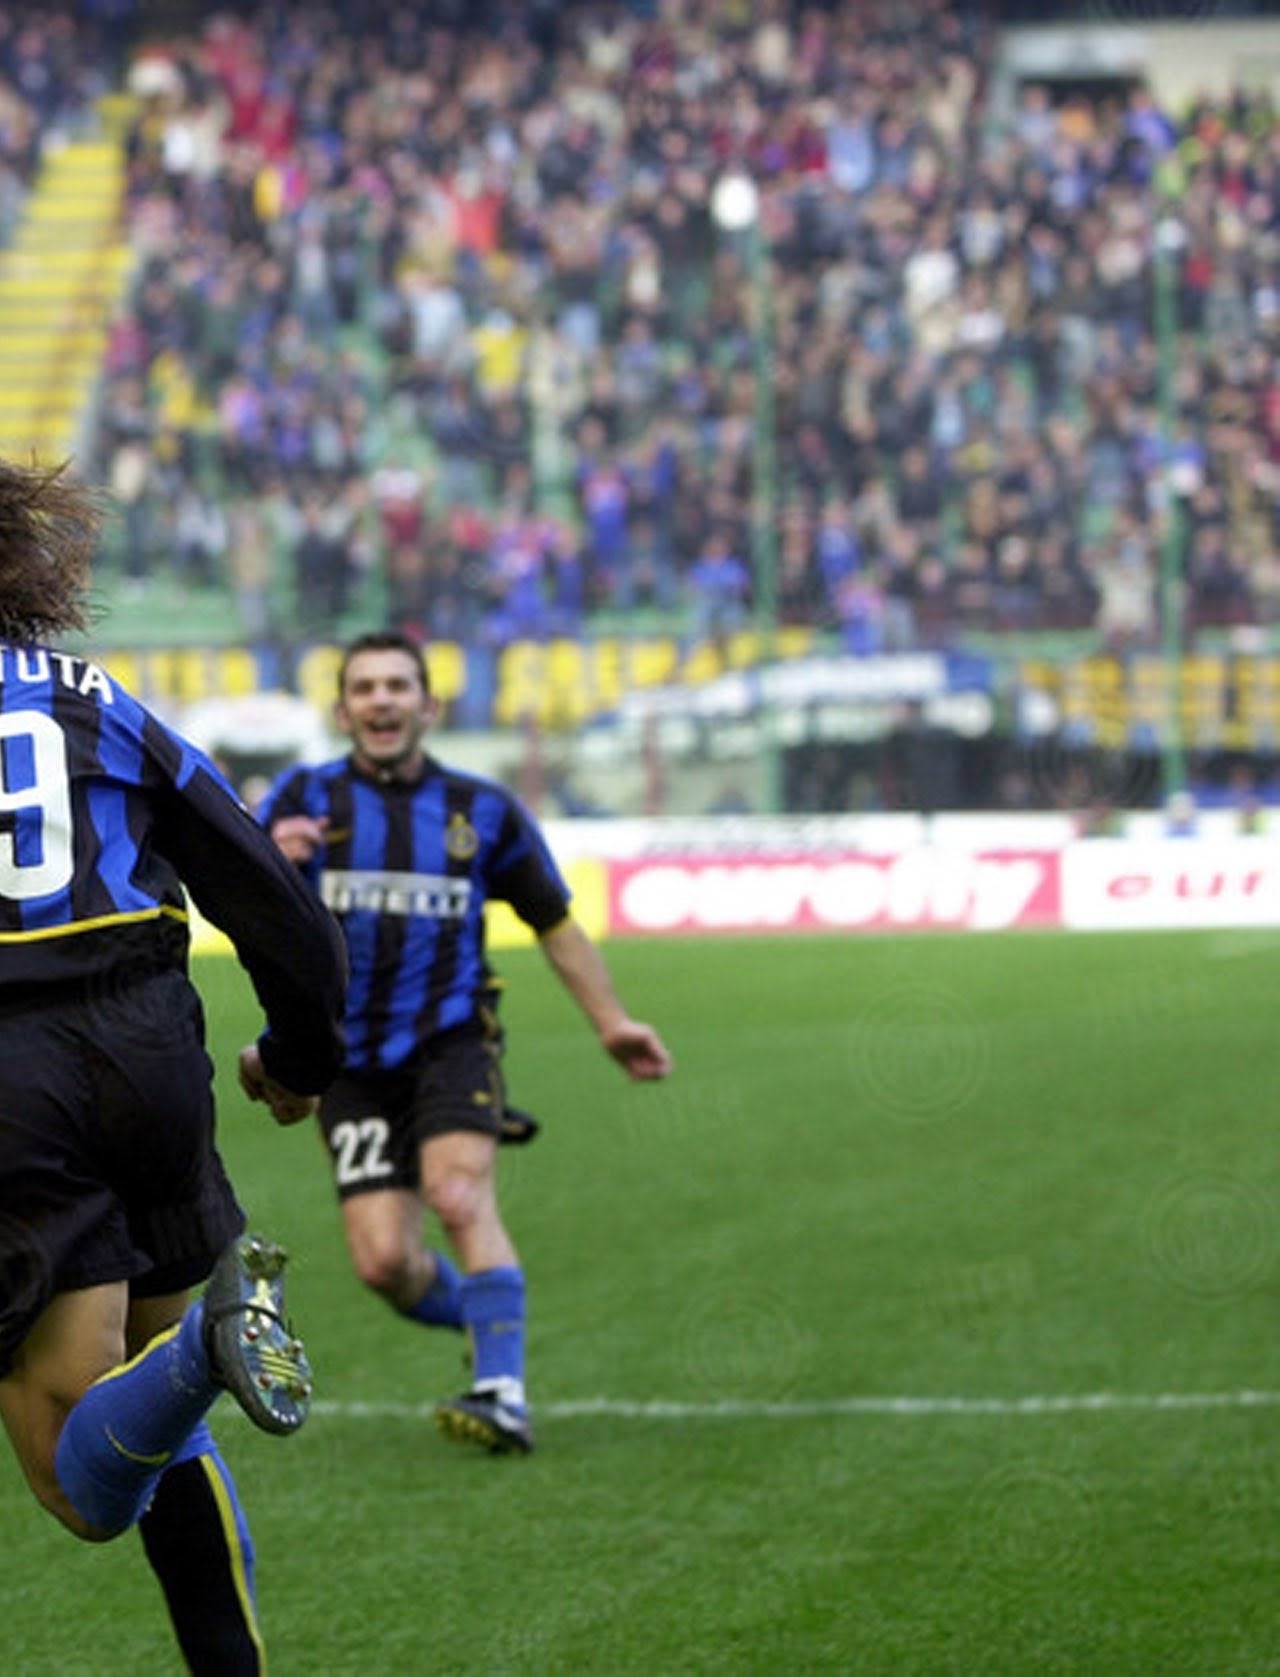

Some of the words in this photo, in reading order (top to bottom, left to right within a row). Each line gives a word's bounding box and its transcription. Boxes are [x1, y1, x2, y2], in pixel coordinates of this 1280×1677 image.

[322, 869, 472, 918] PIRELLI
[621, 846, 1044, 930] eurofly
[332, 1117, 394, 1184] 22
